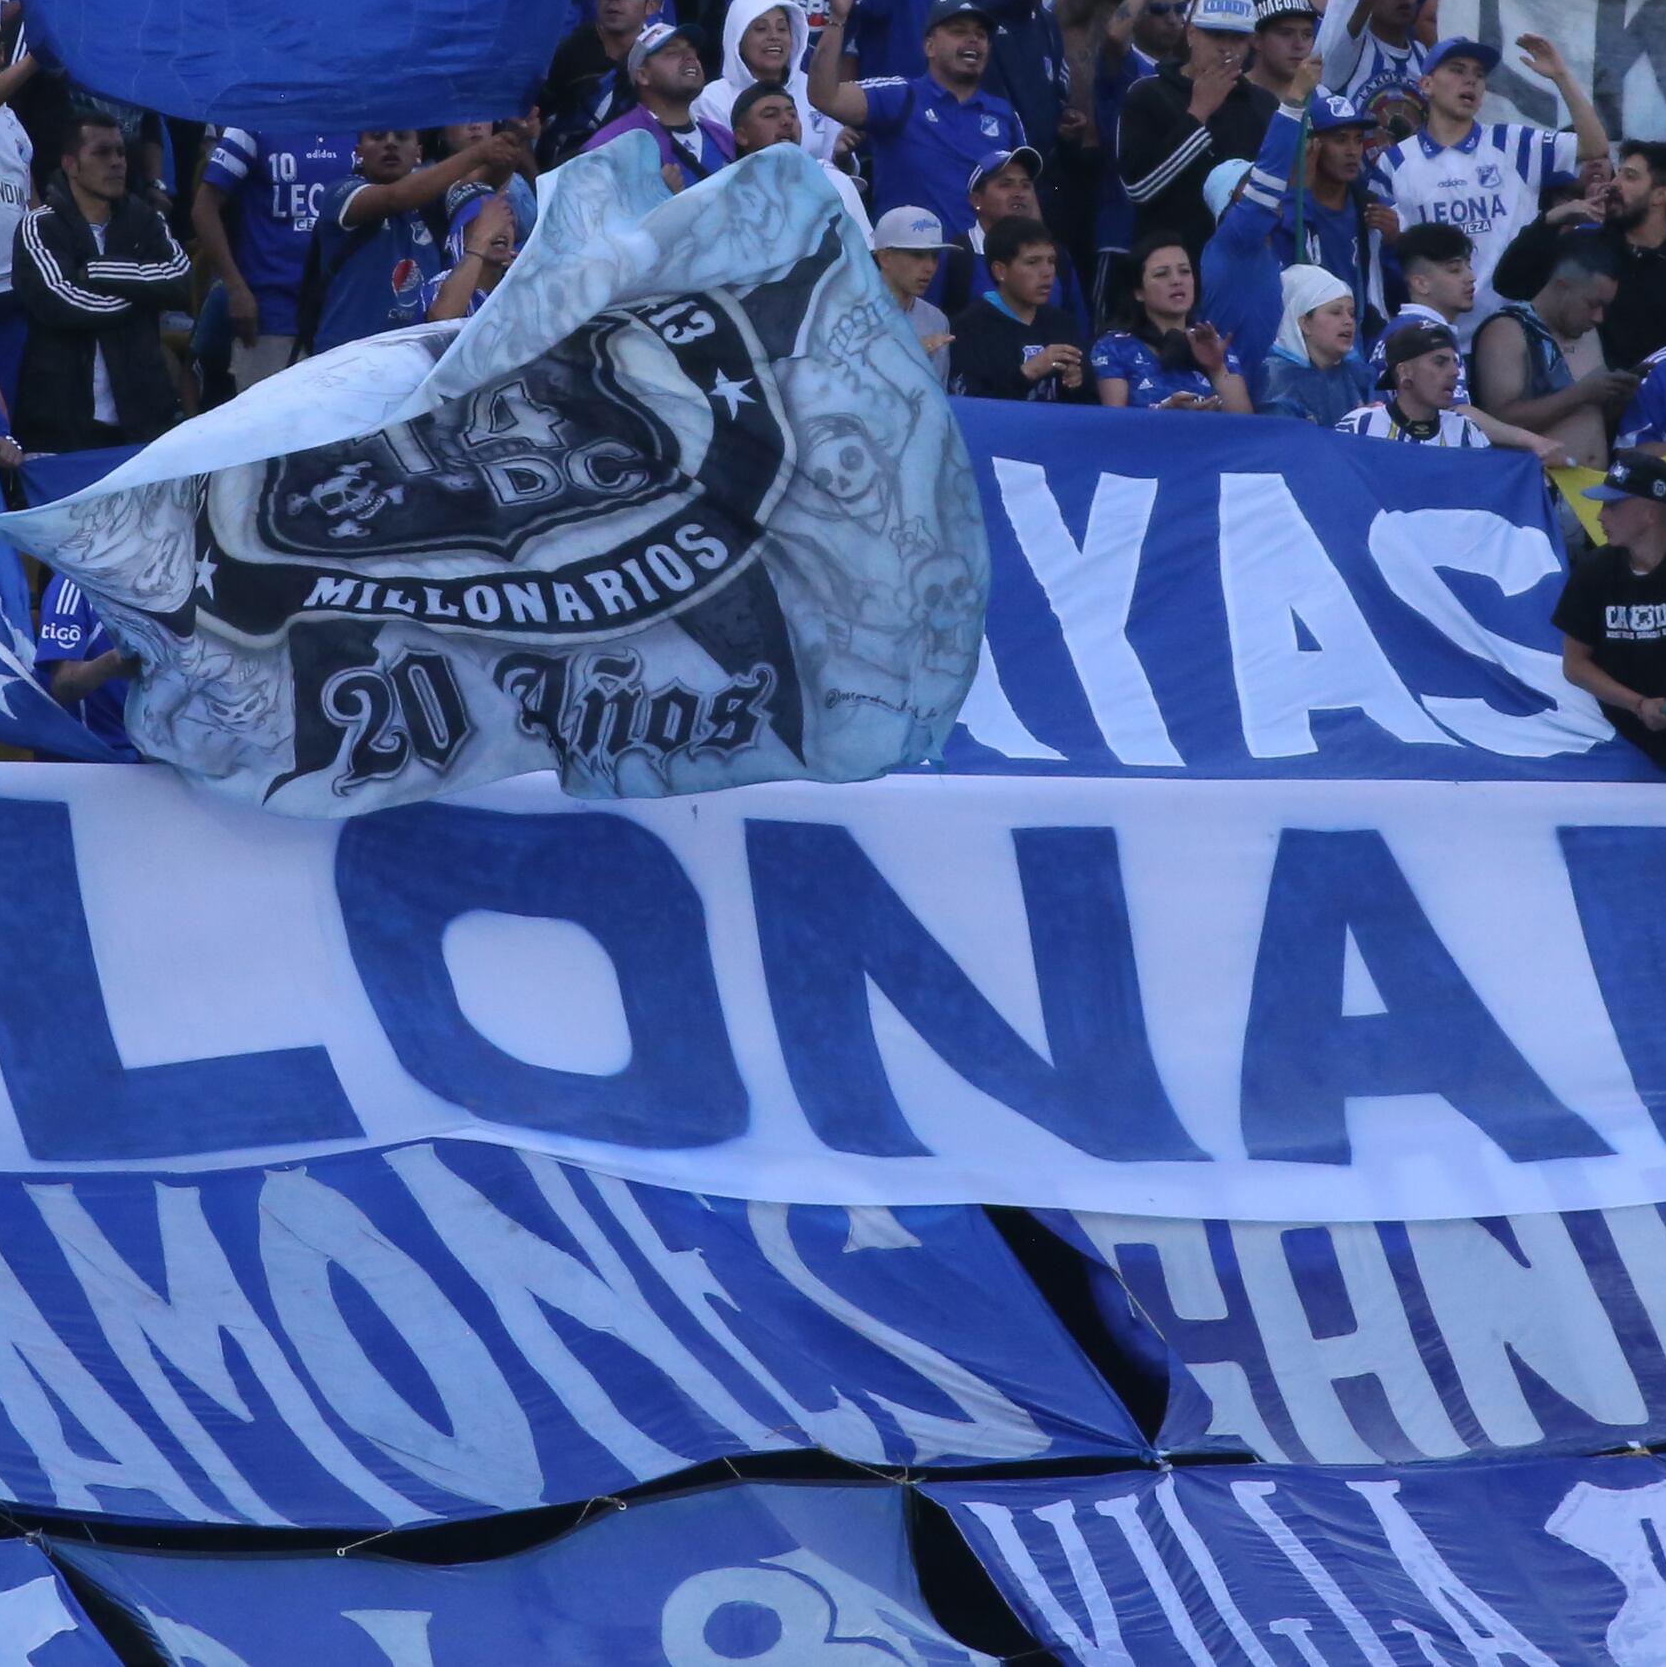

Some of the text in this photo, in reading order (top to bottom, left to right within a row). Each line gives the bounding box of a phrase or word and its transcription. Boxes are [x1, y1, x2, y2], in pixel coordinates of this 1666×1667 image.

[268, 153, 296, 183] 10
[305, 147, 338, 161] adidas
[1437, 178, 1468, 189] adidas
[272, 183, 324, 220] LEO
[1418, 196, 1507, 228] LEONA
[1457, 220, 1492, 234] VEZA
[478, 439, 649, 508] DC
[302, 522, 729, 624] MILLONARIOS
[958, 456, 1616, 767] YAS
[322, 646, 780, 796] 20 Años
